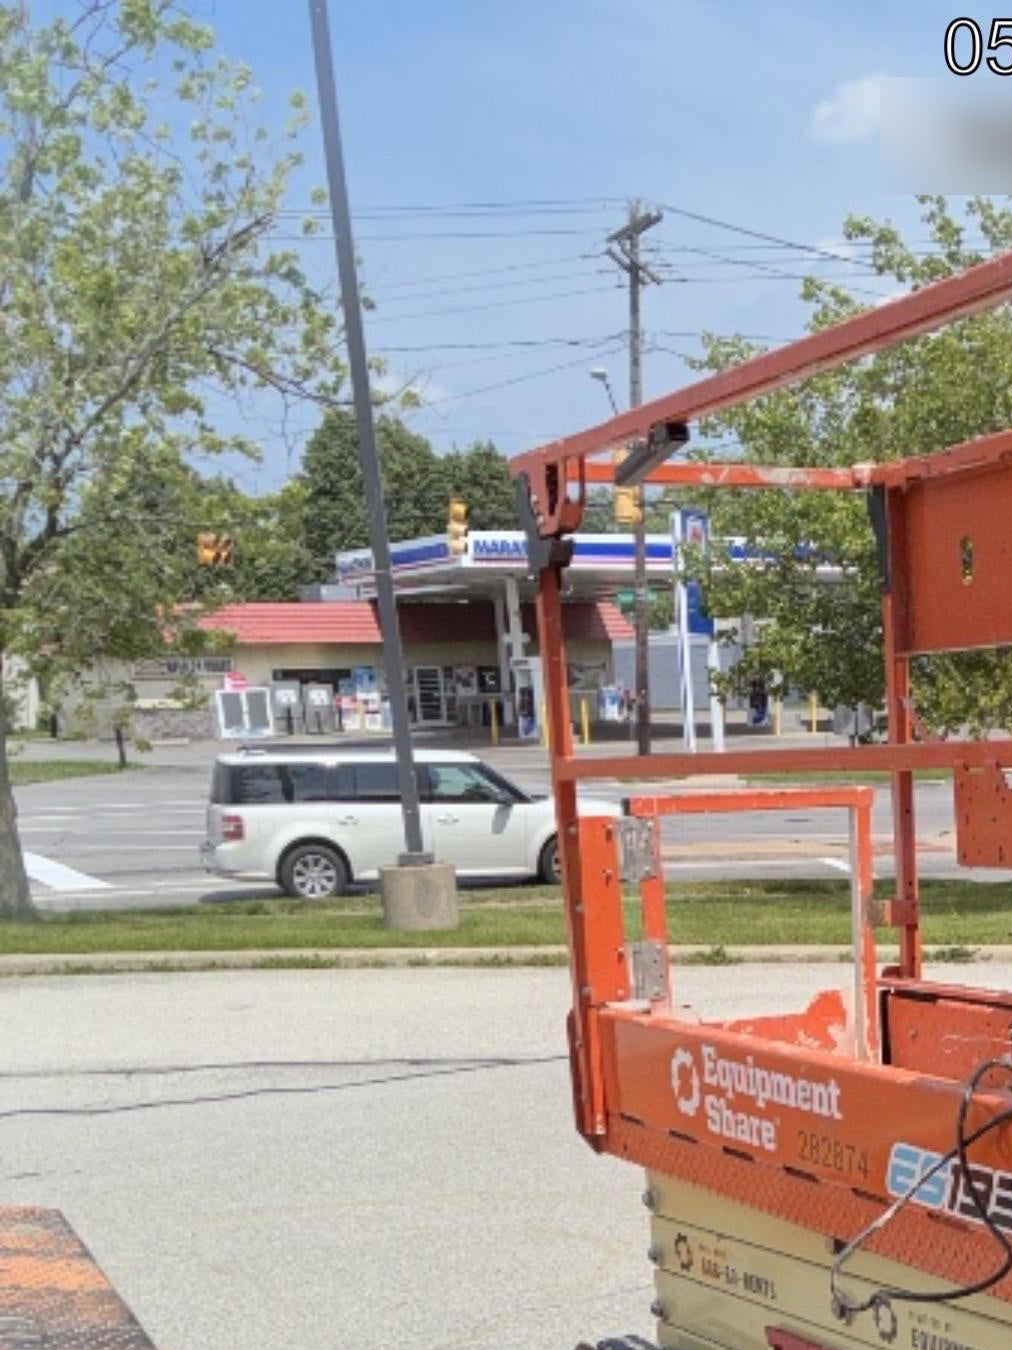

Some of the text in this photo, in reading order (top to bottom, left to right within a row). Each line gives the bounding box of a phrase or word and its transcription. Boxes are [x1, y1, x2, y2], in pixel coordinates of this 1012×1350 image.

[701, 1044, 843, 1120] Equipment
[704, 1094, 778, 1151] Share
[797, 1130, 871, 1179] 282874
